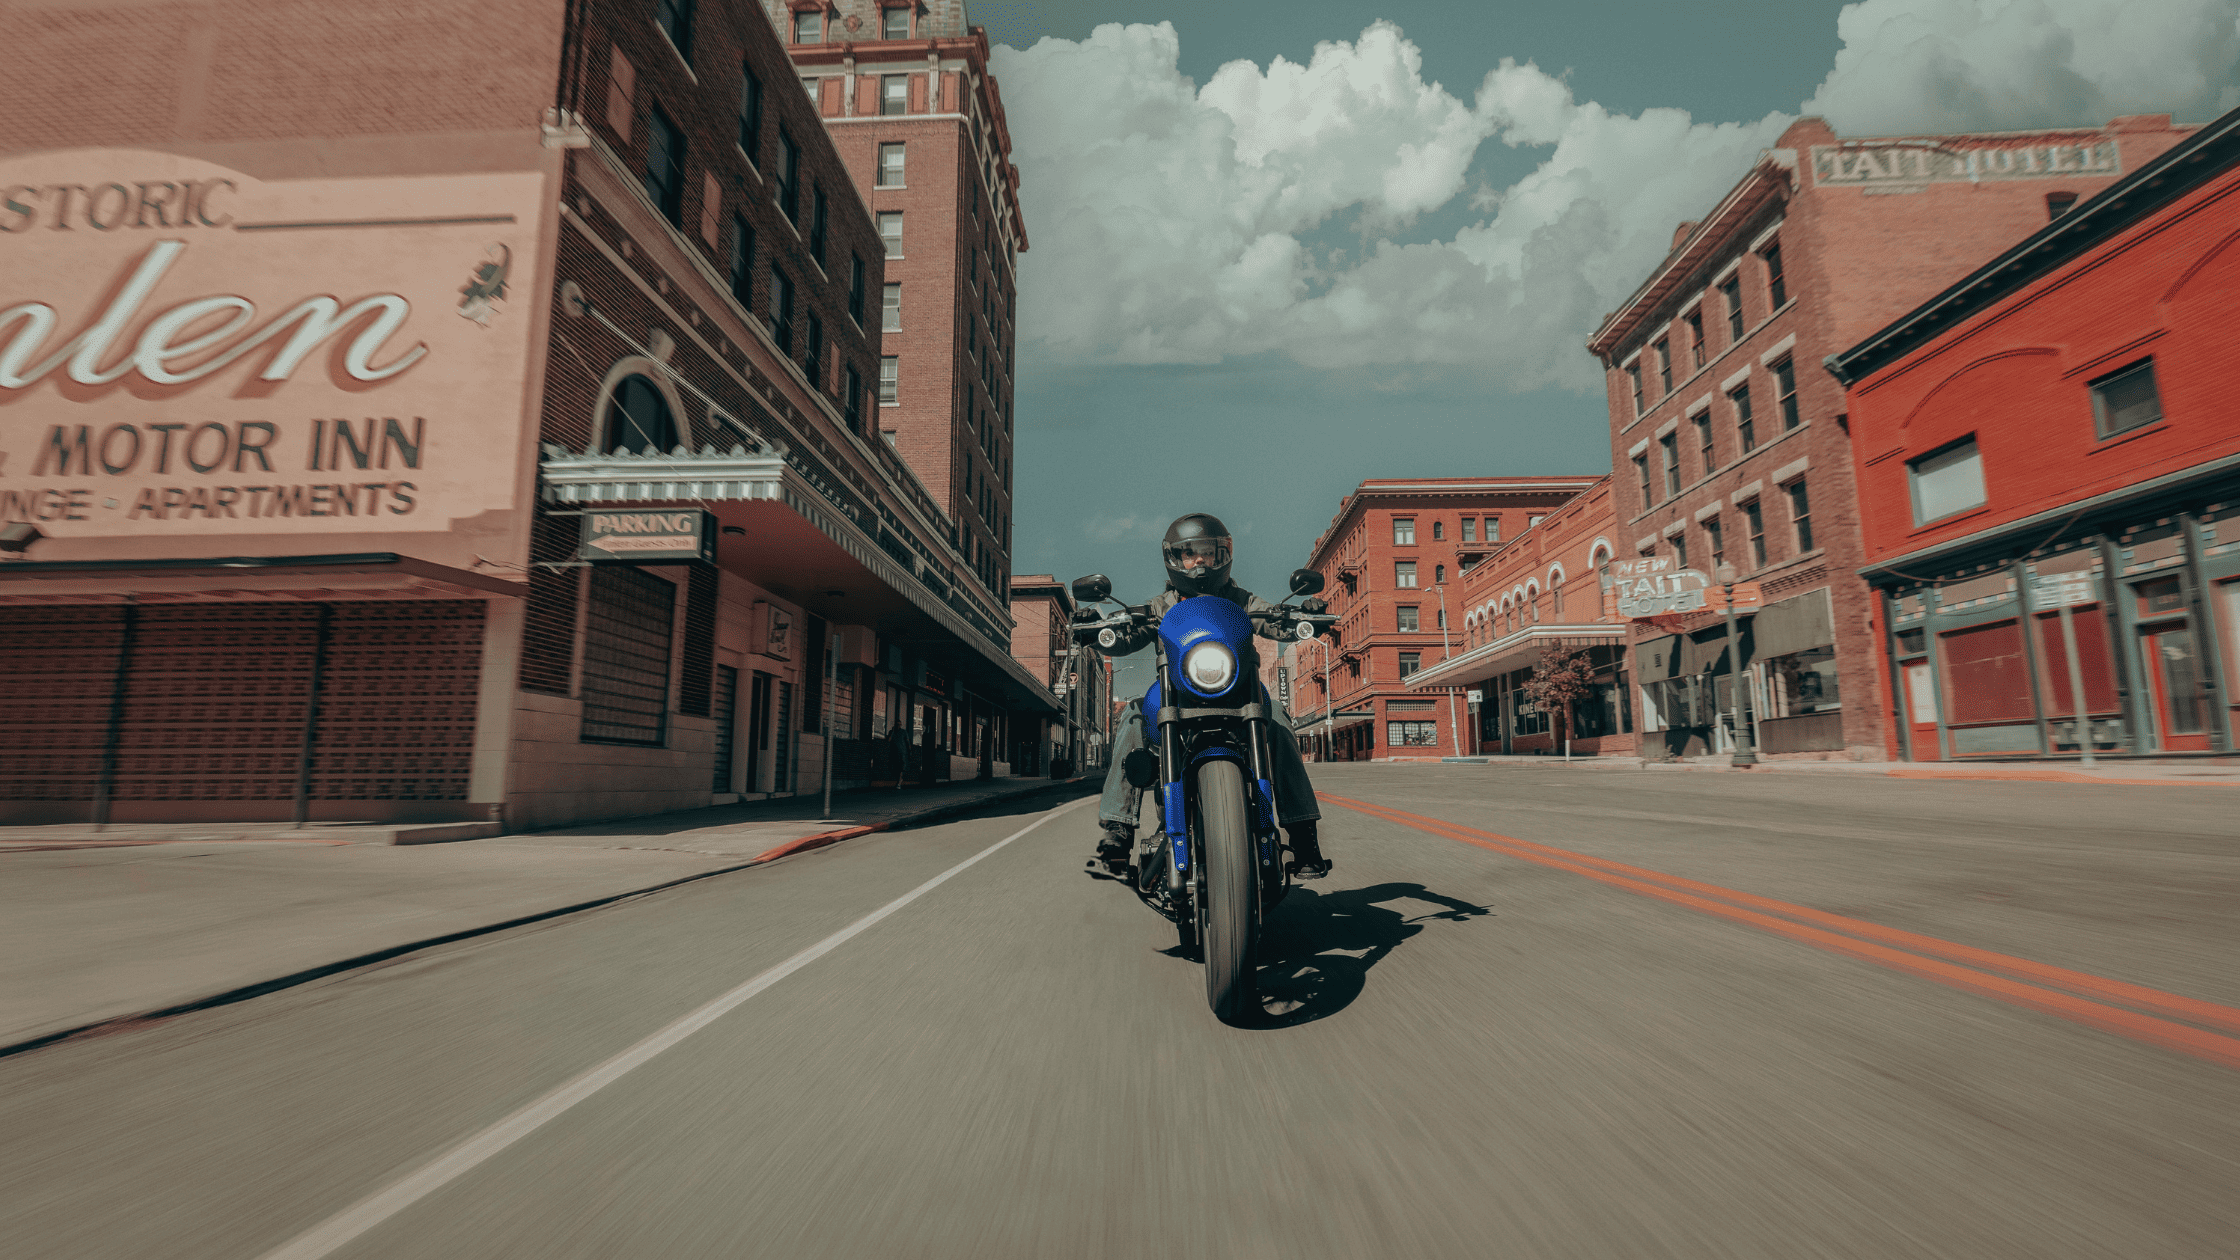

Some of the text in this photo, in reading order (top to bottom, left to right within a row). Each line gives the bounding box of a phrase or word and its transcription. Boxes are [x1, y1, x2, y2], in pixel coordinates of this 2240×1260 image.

[1821, 148, 1934, 182] TAIT
[33, 418, 280, 477] MOTOR
[309, 417, 426, 472] INN
[128, 482, 417, 520] APARTMENTS
[592, 513, 692, 533] PARKING
[1619, 559, 1668, 574] NEW
[1615, 572, 1686, 598] TAIT
